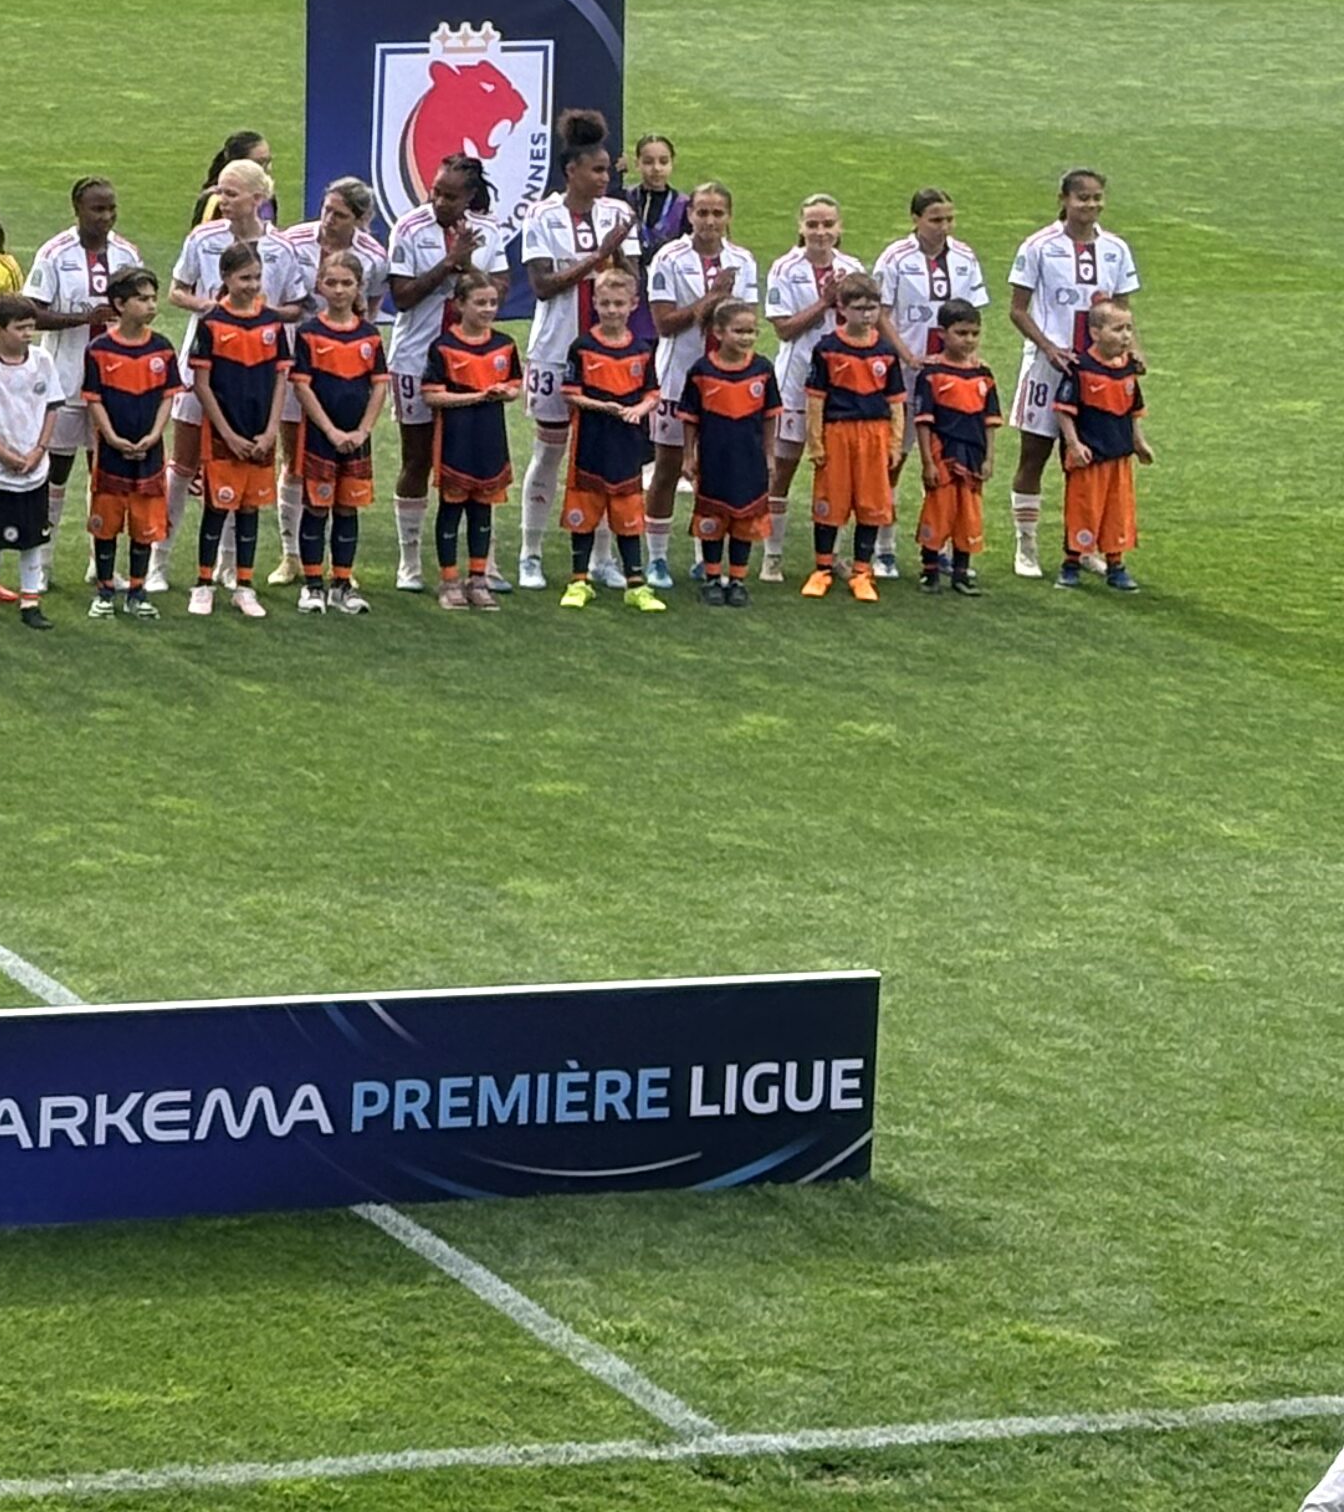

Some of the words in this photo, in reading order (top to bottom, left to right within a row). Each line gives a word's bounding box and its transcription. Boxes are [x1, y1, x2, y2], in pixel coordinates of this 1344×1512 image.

[401, 374, 415, 400] 9
[528, 369, 555, 396] 33
[1027, 379, 1050, 408] 18
[349, 1058, 673, 1134] PREMIÈRE
[687, 1055, 866, 1120] LIGUE
